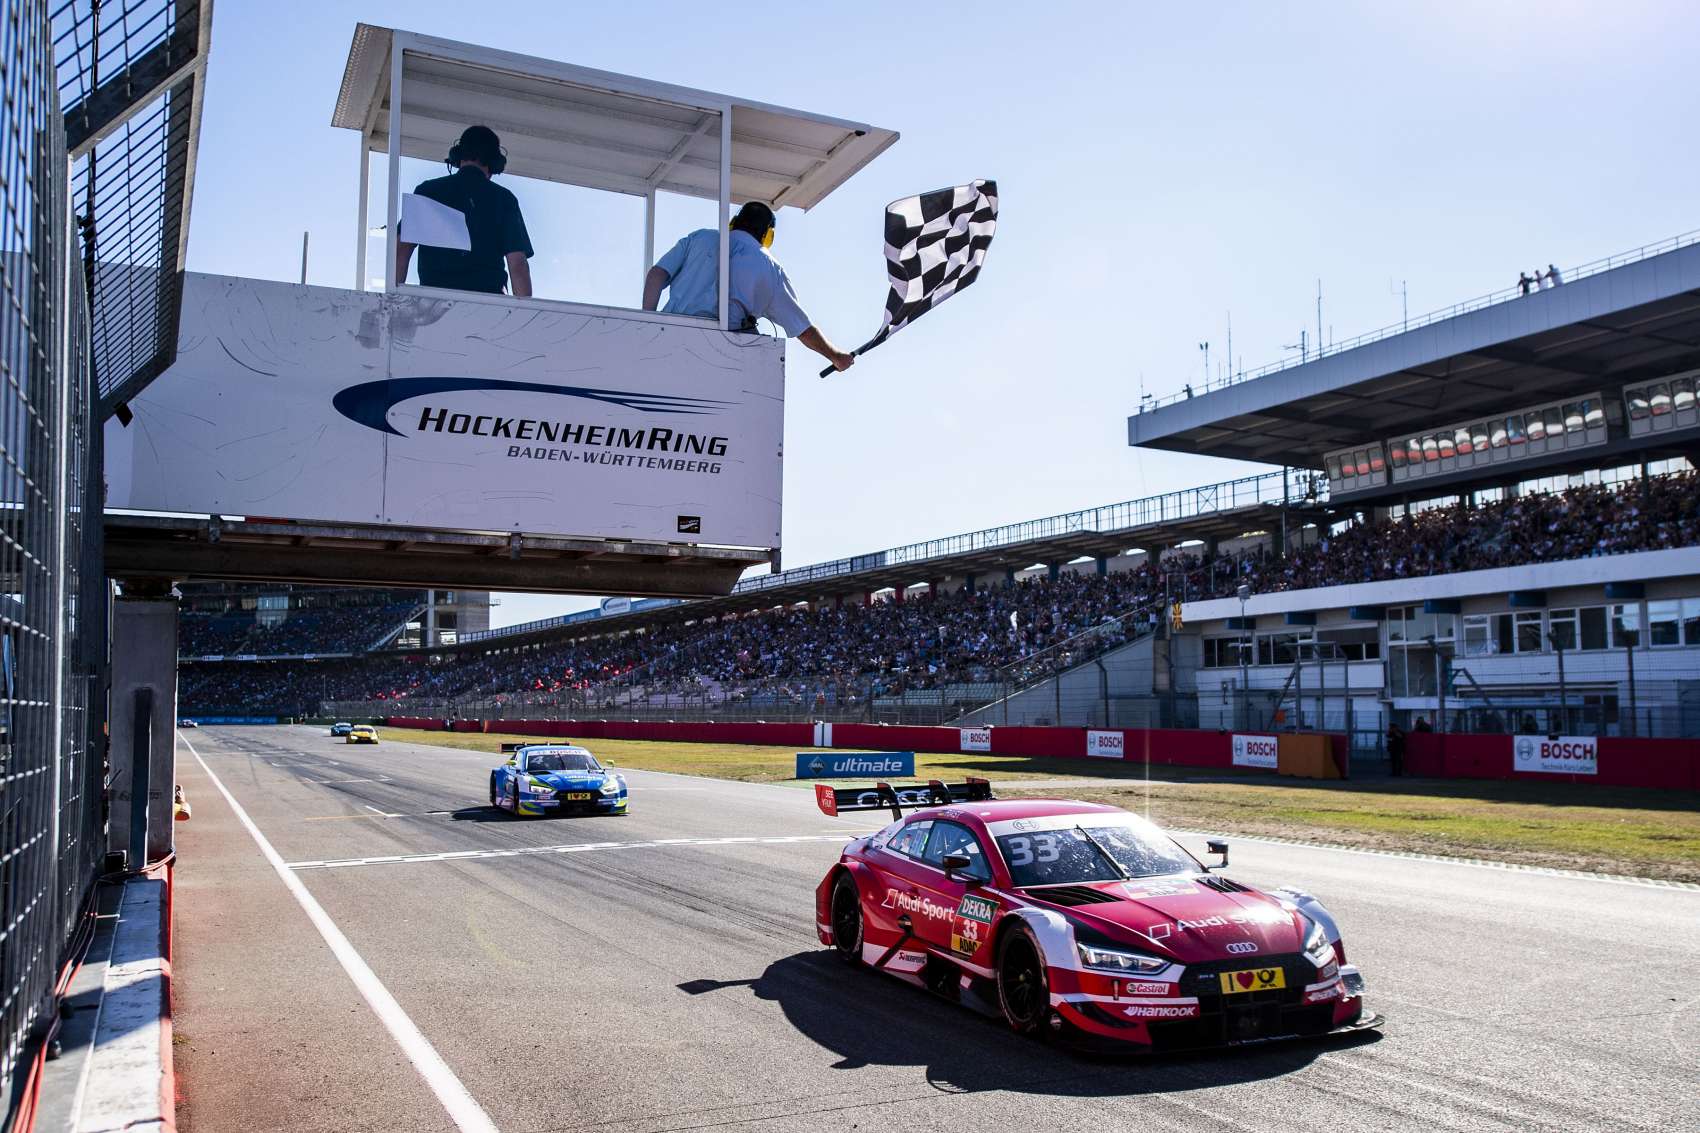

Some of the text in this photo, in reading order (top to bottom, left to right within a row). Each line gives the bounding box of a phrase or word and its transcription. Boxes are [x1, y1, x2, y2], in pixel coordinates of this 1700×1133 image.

[507, 445, 721, 474] BADEN-WÜRTTEMBERG
[971, 732, 990, 743] BOSCH
[1098, 736, 1122, 749] BOSCH
[1247, 741, 1276, 756] BOSCH
[1540, 743, 1594, 760] BOSCH
[833, 758, 902, 772] ultimate
[1007, 834, 1060, 866] 33
[897, 891, 954, 922] Audi Sport
[962, 899, 991, 920] DEKRA
[963, 919, 978, 940] 33
[1177, 914, 1228, 931] Audi
[959, 939, 978, 953] ADAC
[1136, 983, 1167, 993] Castrol
